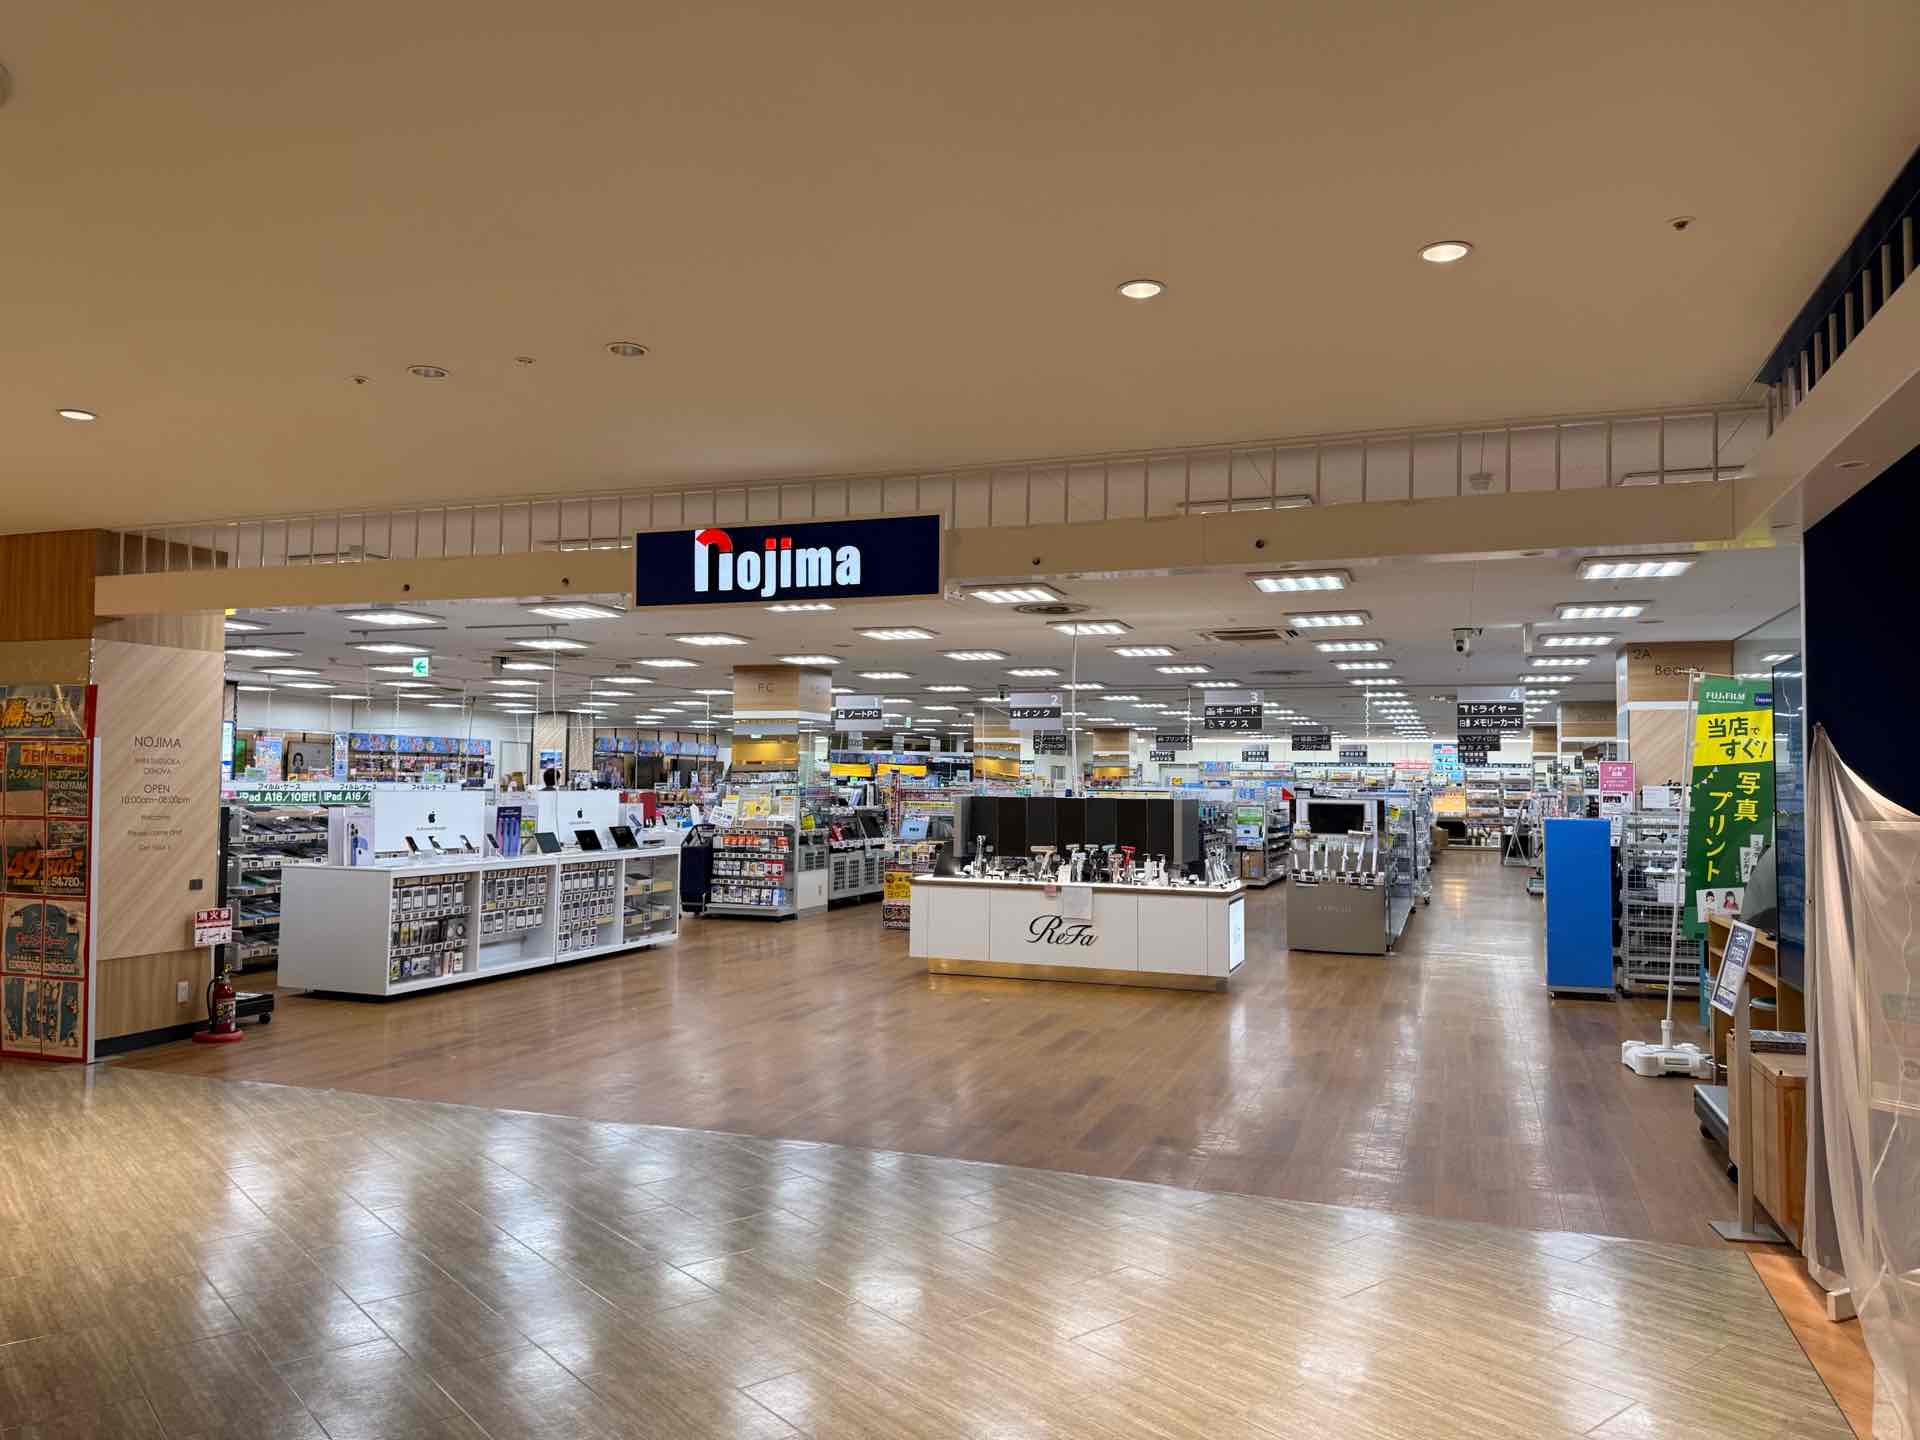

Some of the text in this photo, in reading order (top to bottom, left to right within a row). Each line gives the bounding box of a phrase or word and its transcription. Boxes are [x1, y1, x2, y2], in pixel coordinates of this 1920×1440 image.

[694, 528, 861, 597] nojima
[1250, 691, 1258, 703] 3
[1510, 687, 1520, 700] 4
[1050, 694, 1058, 705] 2
[848, 709, 879, 718] ノートPC
[1023, 709, 1050, 718] インク
[1216, 706, 1258, 716] キーボード
[1471, 704, 1517, 714] ドライヤー
[1217, 719, 1249, 728] マウス
[1472, 717, 1521, 728] メモリーカード
[1708, 716, 1760, 739] 当店で
[134, 735, 182, 749] NOJIMA
[143, 784, 171, 794] OPEN
[1734, 771, 1761, 822] 写真
[1706, 791, 1733, 882] プリント
[1025, 914, 1097, 947] ReFa
